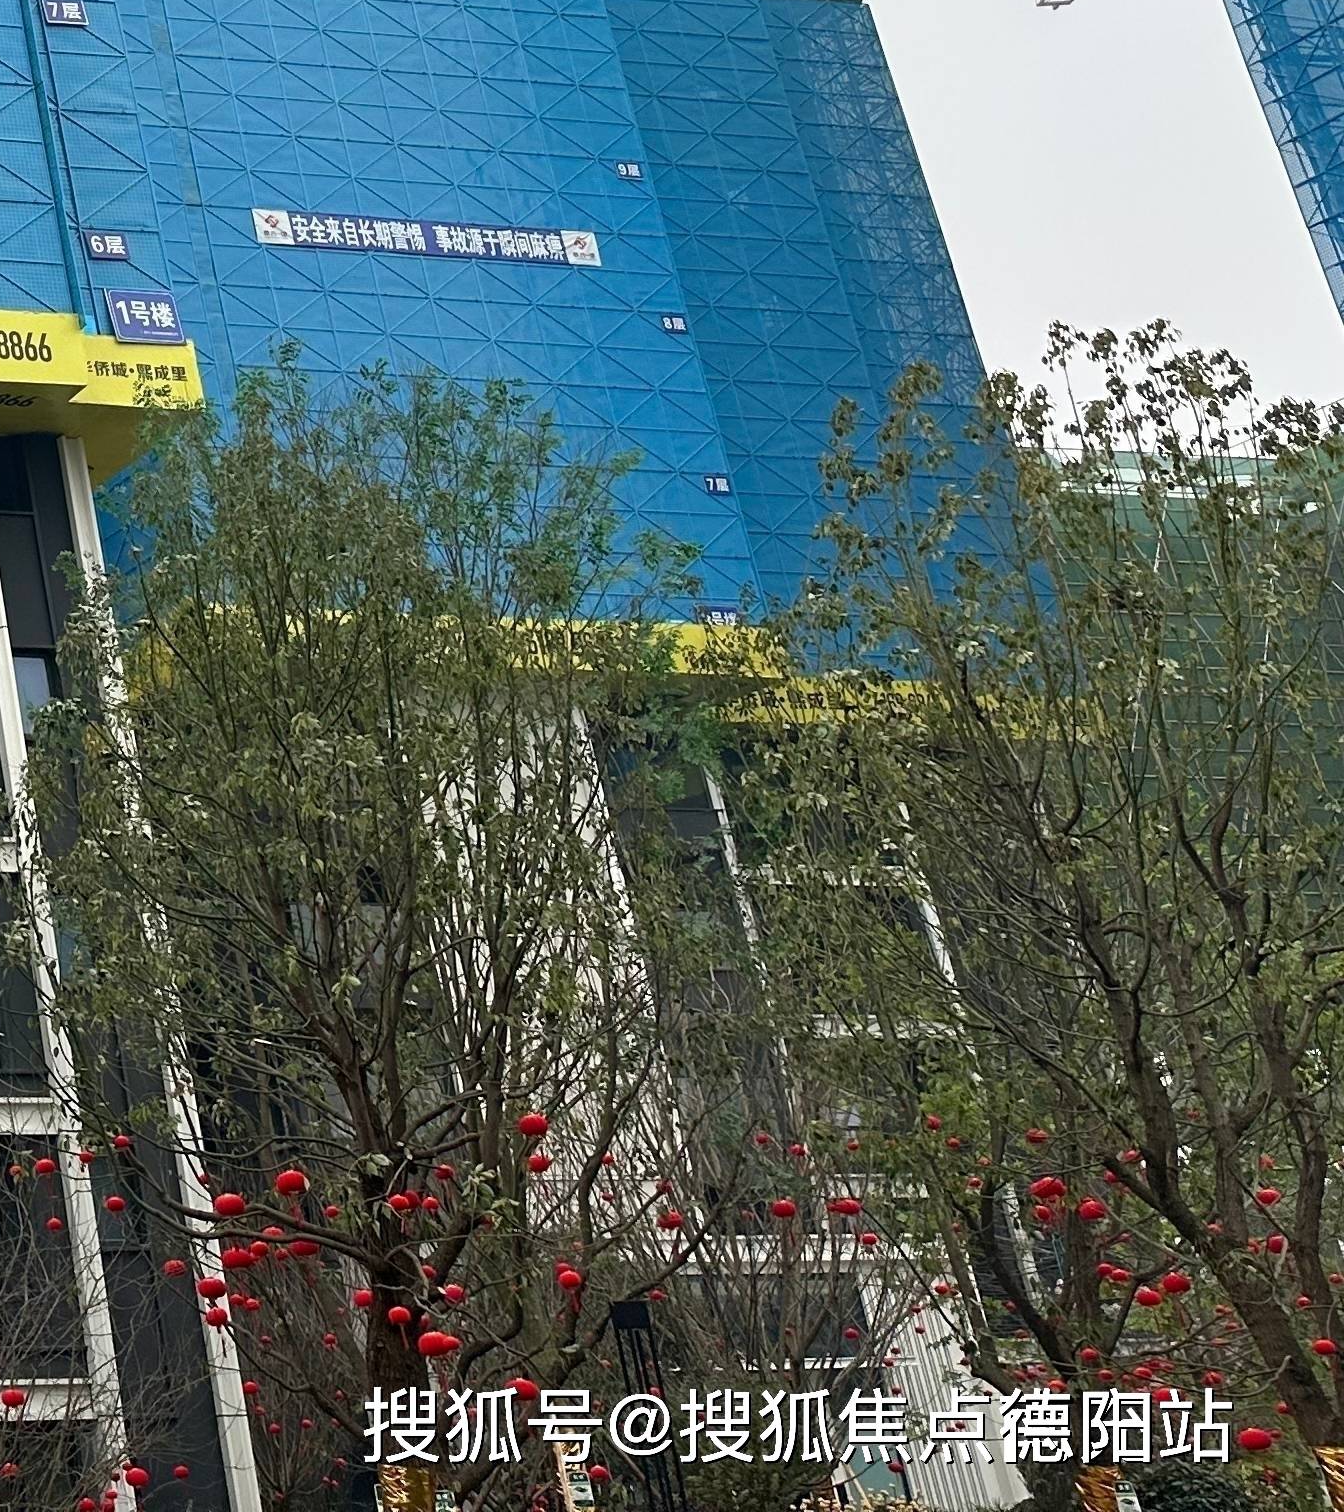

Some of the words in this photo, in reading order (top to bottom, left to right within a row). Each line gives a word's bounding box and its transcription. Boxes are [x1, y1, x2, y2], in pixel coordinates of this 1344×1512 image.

[47, 1, 82, 19] 7层
[617, 163, 641, 177] 9层
[90, 235, 126, 254] 6层
[291, 214, 427, 251] 安全来自长期警惕
[432, 224, 565, 260] 事故源于瞬间麻痹
[115, 300, 176, 328] 1号楼
[662, 317, 687, 331] 8层
[705, 478, 730, 492] 7层
